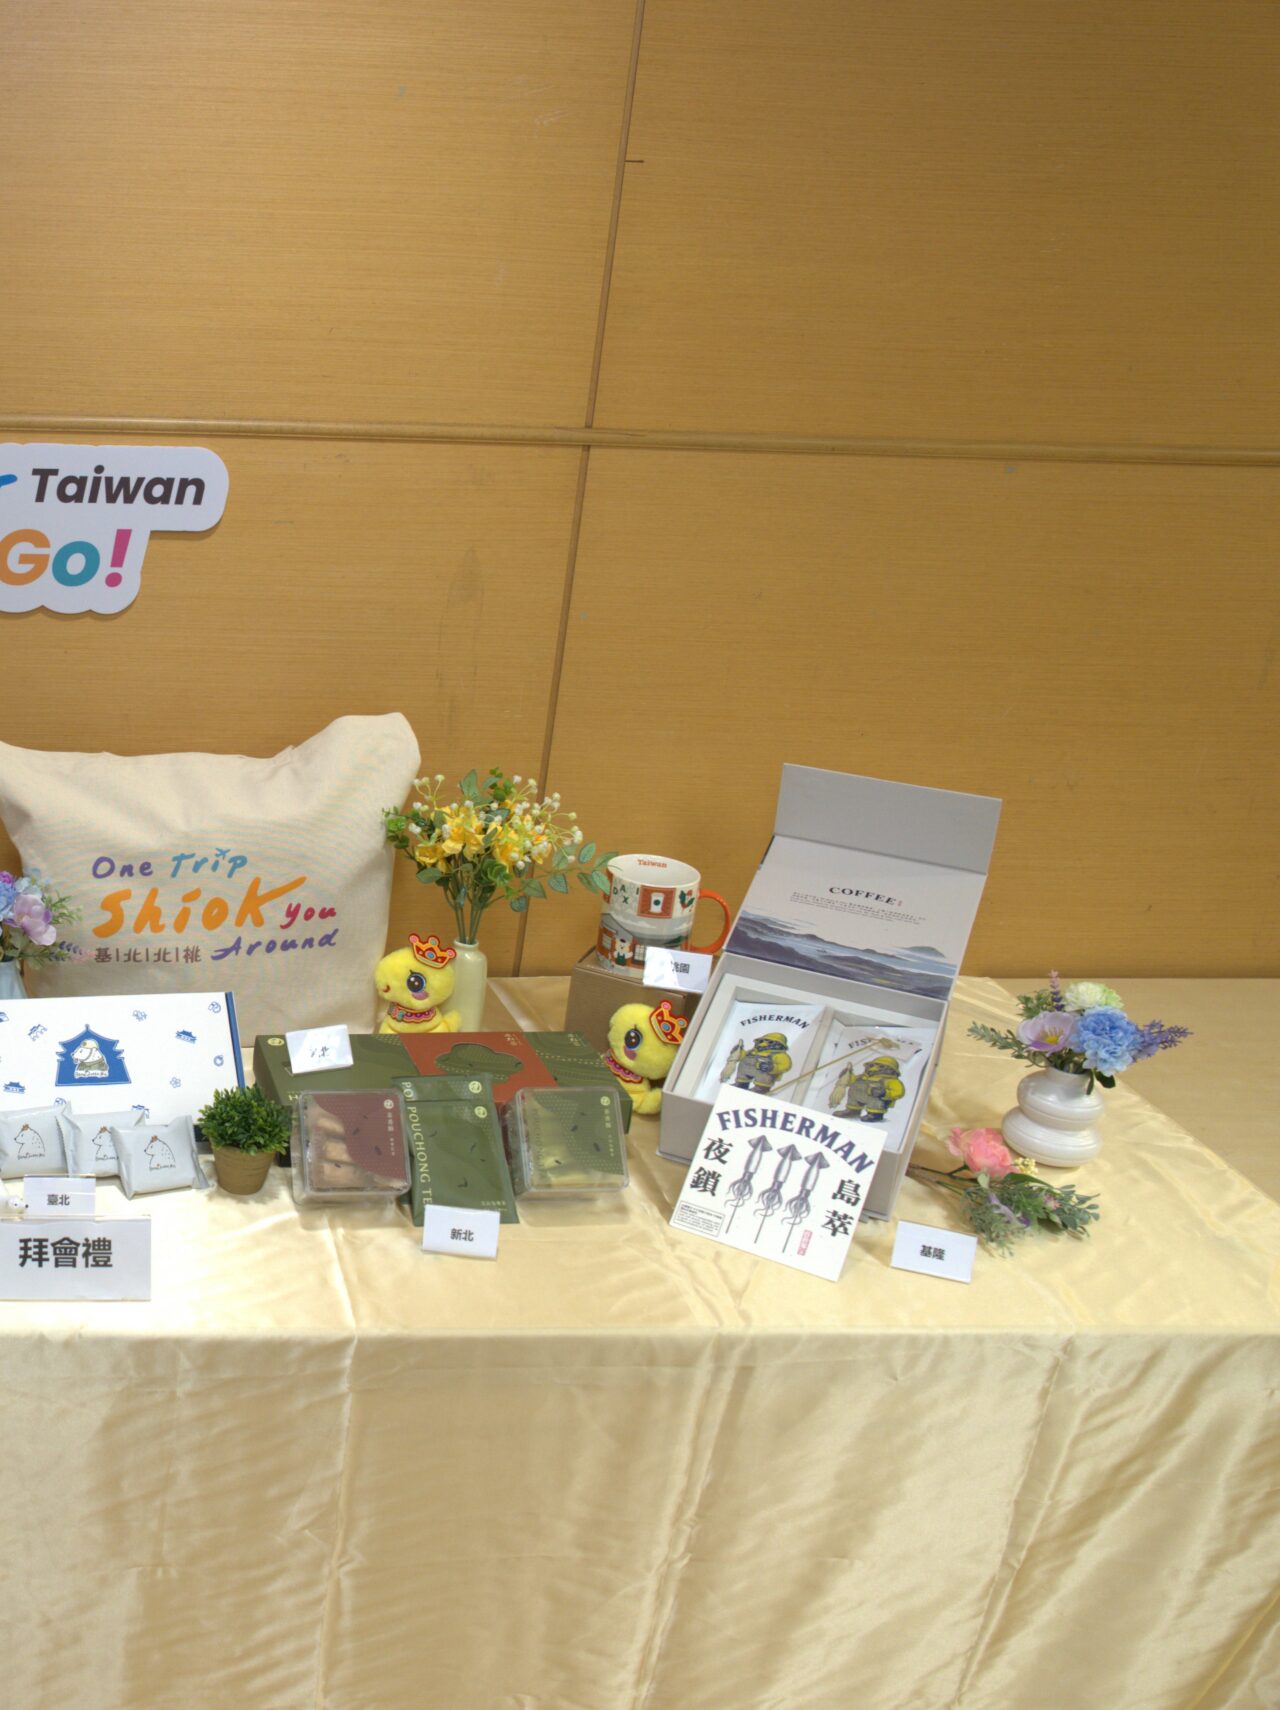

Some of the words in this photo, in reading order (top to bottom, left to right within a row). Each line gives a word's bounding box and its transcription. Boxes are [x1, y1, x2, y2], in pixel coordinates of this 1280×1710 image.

[31, 464, 206, 506] Taiwan
[92, 856, 154, 879] One
[170, 848, 248, 879] Trip
[637, 858, 668, 869] Taiwan
[828, 886, 897, 906] COFFEE
[279, 902, 337, 930] you
[210, 928, 340, 961] Around
[740, 1014, 810, 1030] FISHERMAN
[407, 1106, 431, 1183] POUCHONG
[716, 1108, 874, 1175] FISHERMAN
[47, 1194, 70, 1206] 臺北
[450, 1228, 474, 1242] 新北
[18, 1237, 113, 1269] 拜會禮
[920, 1244, 946, 1261] 基隆
